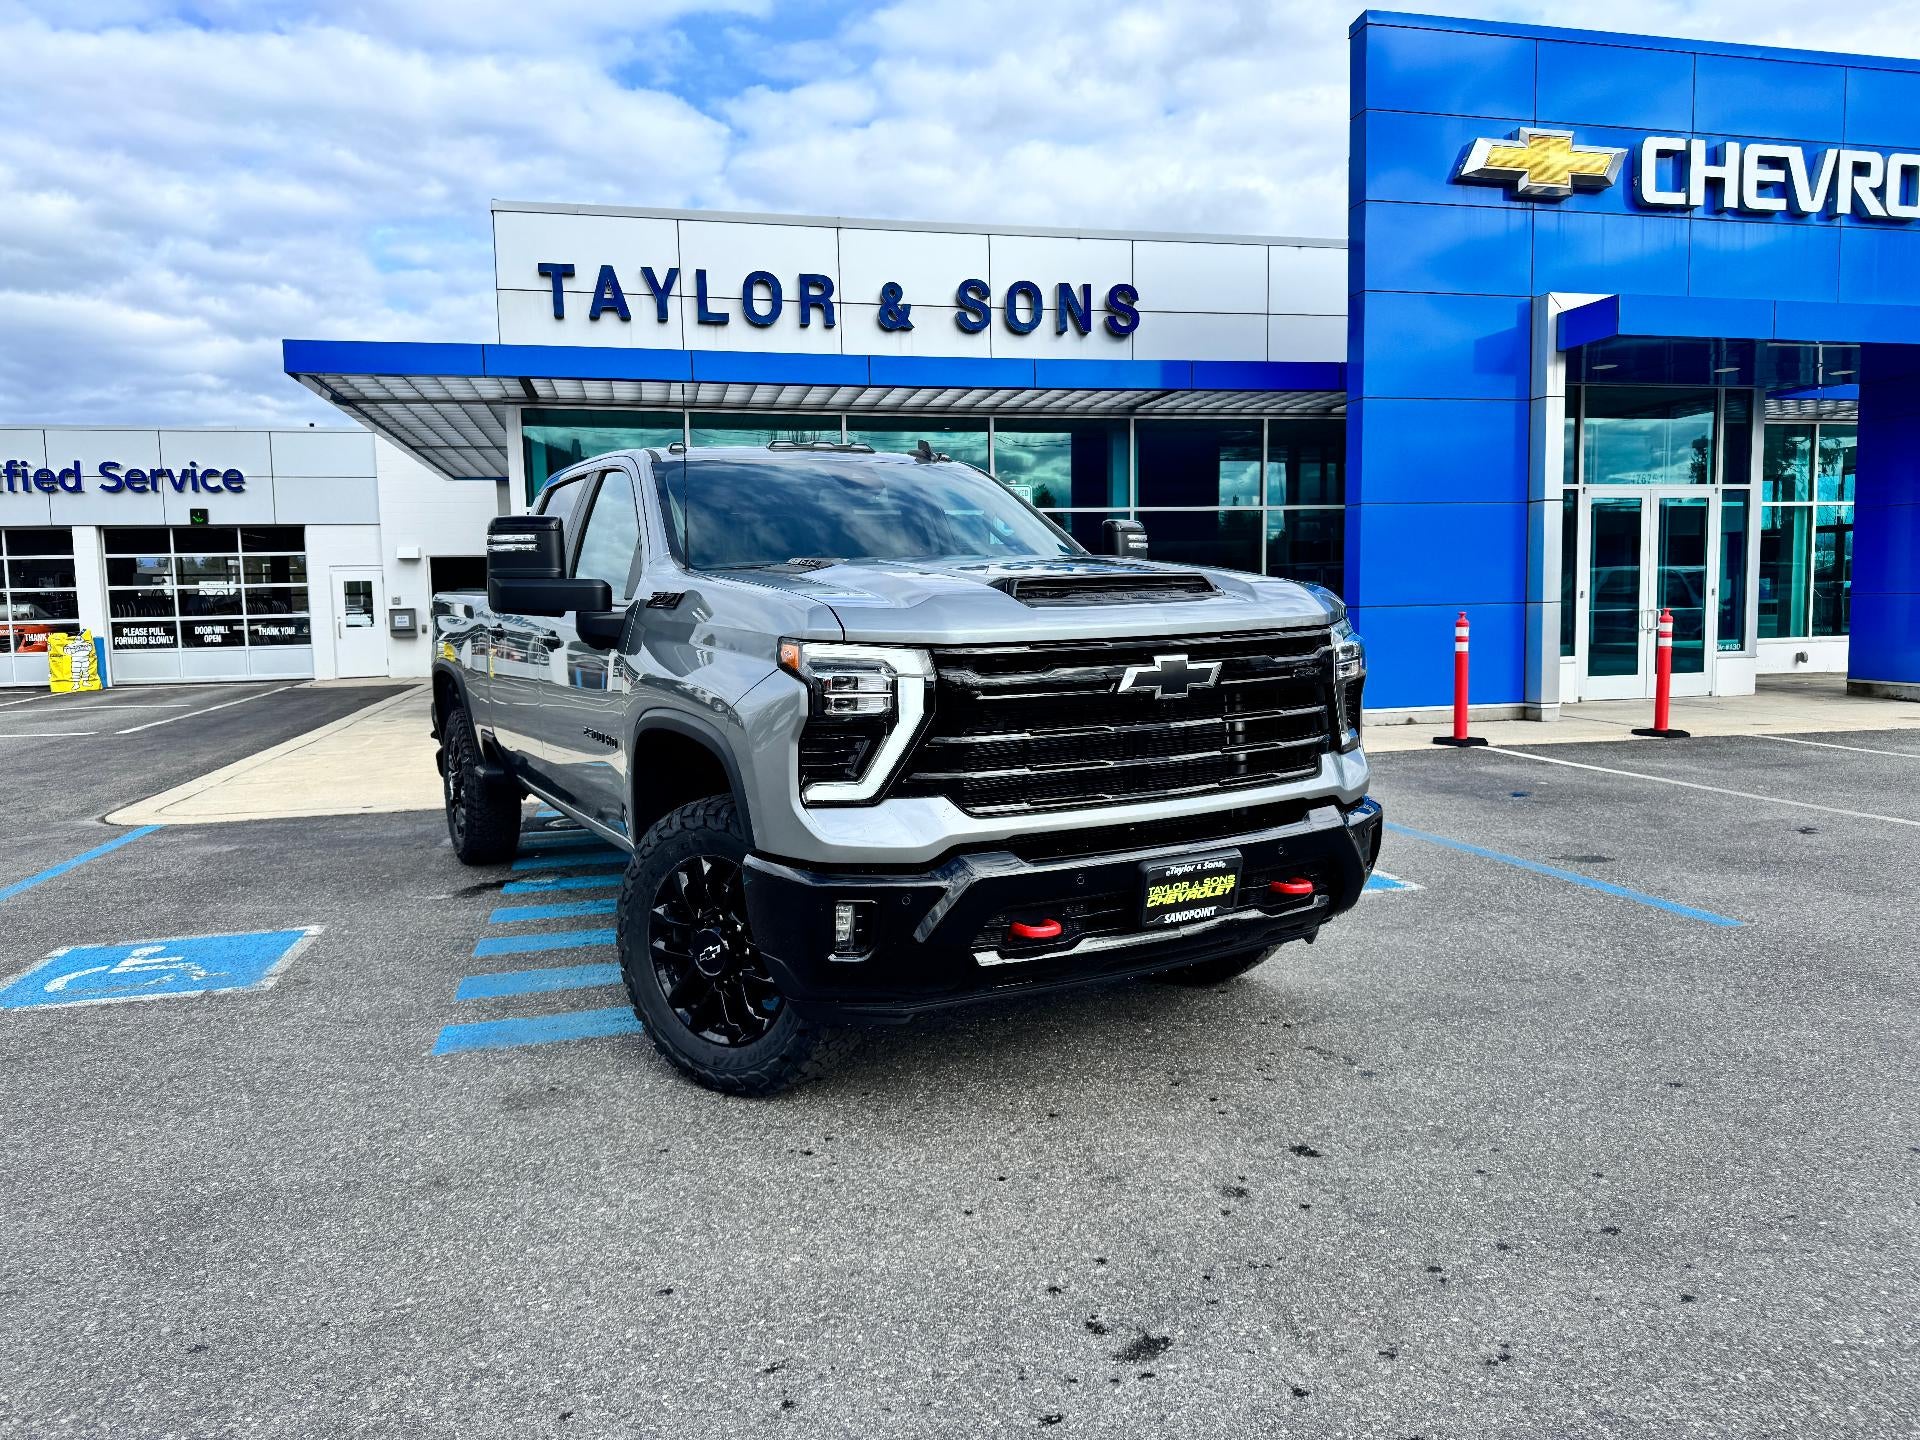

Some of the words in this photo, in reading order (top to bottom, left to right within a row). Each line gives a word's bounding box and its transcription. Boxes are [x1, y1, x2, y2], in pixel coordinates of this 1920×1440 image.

[538, 262, 836, 328] TAYLOR
[878, 281, 914, 332] &
[954, 278, 1140, 336] SONS
[0, 460, 84, 493] fied
[98, 461, 246, 493] Service
[123, 627, 148, 637] PLEASE
[149, 627, 165, 636] PULL
[195, 626, 213, 634] DOOR
[258, 627, 279, 635] THANK
[280, 627, 296, 635] YOU!
[114, 636, 147, 645] FORWARD
[148, 636, 174, 645] SLOWLY
[204, 635, 221, 643] OPEN
[1148, 881, 1189, 897] TAYLOR
[1193, 880, 1200, 889] &
[1203, 874, 1236, 887] SONS
[1146, 883, 1235, 907] CHEVROLET
[1164, 906, 1217, 923] SANDPOINT
